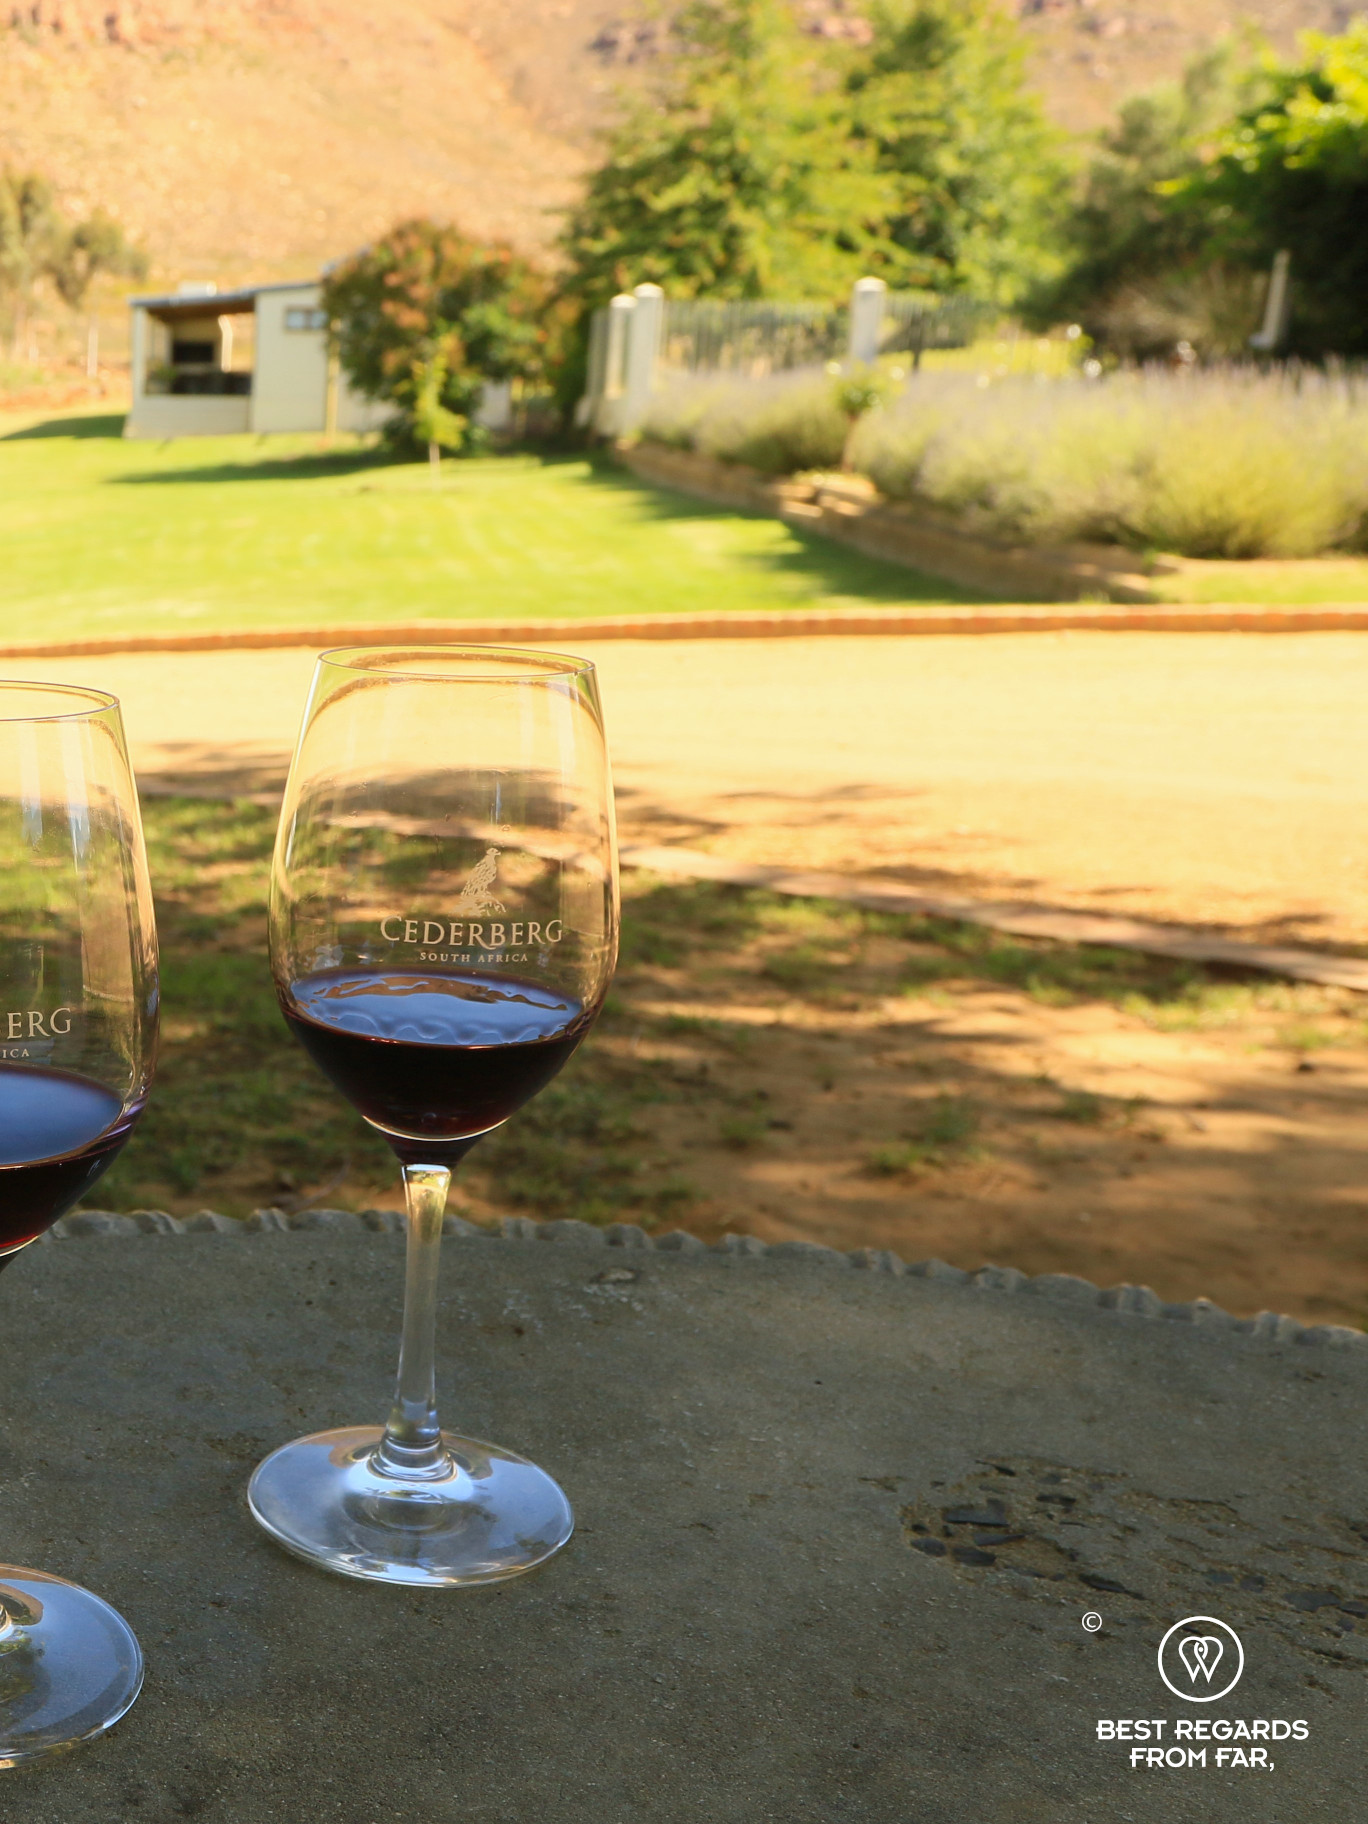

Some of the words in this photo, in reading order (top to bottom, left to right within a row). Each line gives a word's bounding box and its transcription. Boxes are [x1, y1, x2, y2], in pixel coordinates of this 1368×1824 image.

[380, 915, 563, 950] CEDERBERG
[419, 952, 470, 962] SOUTH
[478, 953, 528, 962] AFRICA
